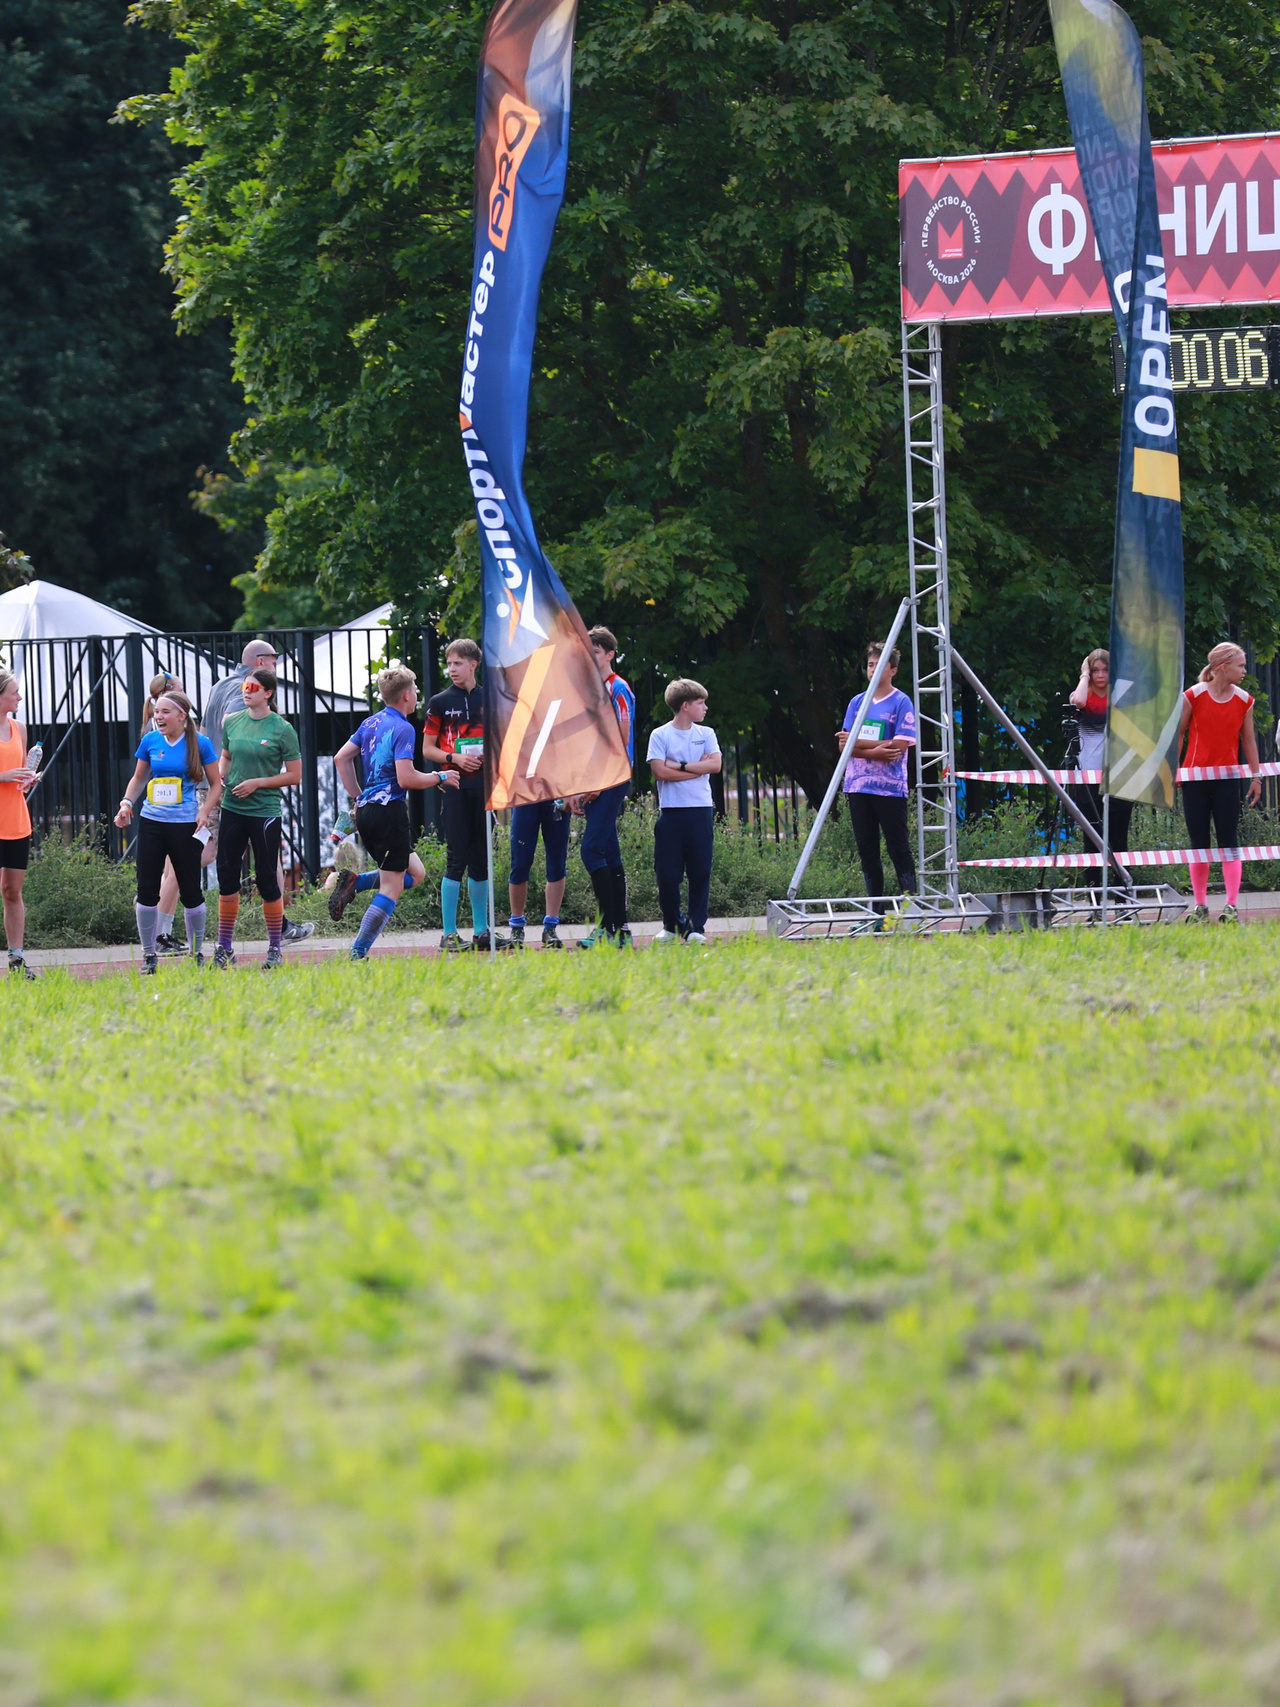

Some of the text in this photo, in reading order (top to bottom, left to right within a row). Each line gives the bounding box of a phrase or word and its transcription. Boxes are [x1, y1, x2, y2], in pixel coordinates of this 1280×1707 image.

[491, 110, 526, 238] PRO
[922, 195, 981, 248] ПЕРВЕНСТВО РОССИИ
[926, 258, 977, 285] МОСКВА 2026
[1027, 179, 1280, 275] ФНИ
[1134, 254, 1175, 437] OPEN
